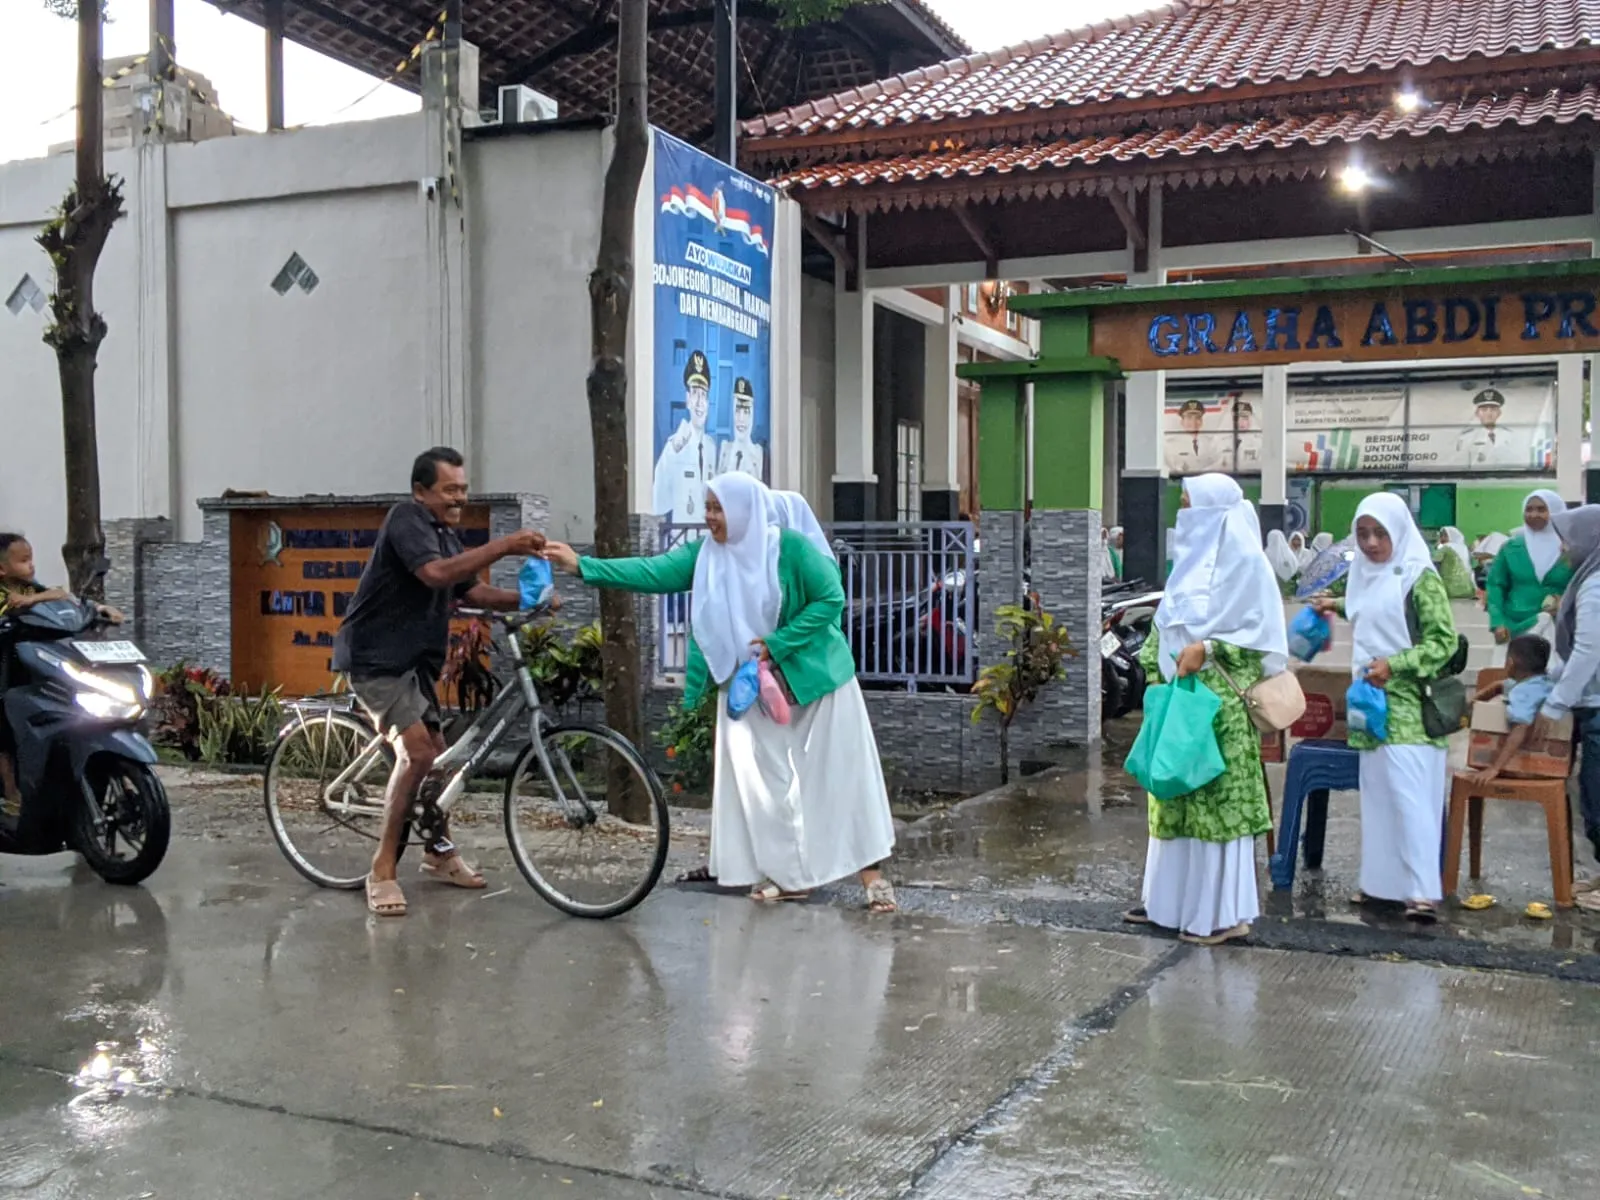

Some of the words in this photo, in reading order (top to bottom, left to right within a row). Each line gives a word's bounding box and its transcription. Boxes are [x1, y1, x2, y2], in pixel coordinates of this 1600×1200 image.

[687, 244, 707, 263] AYO
[653, 263, 710, 294] BOJONEGORO
[1149, 306, 1342, 356] GRAHA
[1360, 296, 1500, 346] ABDI
[1365, 433, 1430, 443] BERSINERGI
[1364, 444, 1401, 453] UNTUK
[1363, 452, 1438, 463] BOJONEGORO
